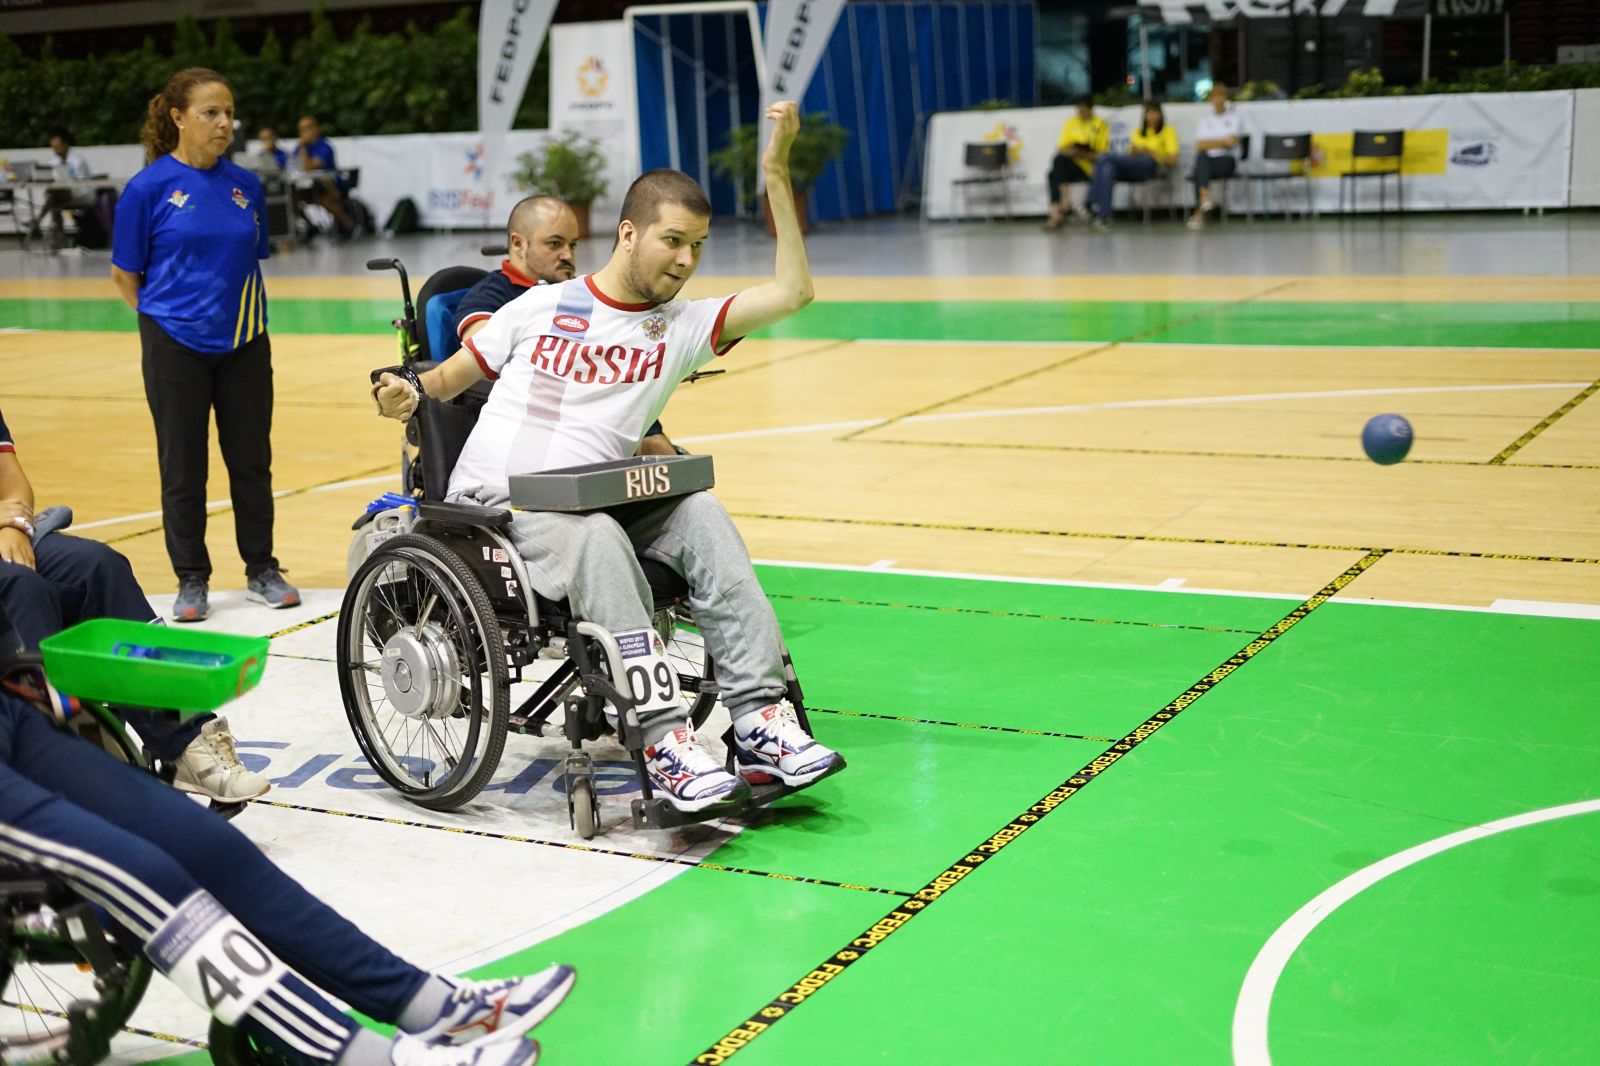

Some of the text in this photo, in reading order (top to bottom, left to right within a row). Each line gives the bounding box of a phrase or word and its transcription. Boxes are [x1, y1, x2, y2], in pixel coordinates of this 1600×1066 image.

[772, 0, 814, 95] FEDP
[530, 335, 667, 384] RUSSIA
[624, 464, 671, 499] RUS
[1273, 616, 1300, 635] FEDPC
[1237, 640, 1270, 657] FEDPC
[626, 661, 675, 706] 09
[1203, 664, 1238, 683] FEDPC
[1165, 691, 1203, 712] FEDPC
[1124, 720, 1165, 744] FEDPC
[1080, 751, 1123, 776] FEDPC
[1031, 786, 1078, 813] FEDPC
[978, 823, 1029, 853] FEDPC
[919, 865, 974, 899] FEDPC
[853, 911, 913, 948] FEDPC
[196, 928, 273, 1012] 40
[779, 963, 845, 1004] FEDPC
[697, 1021, 769, 1065] FEDPC
